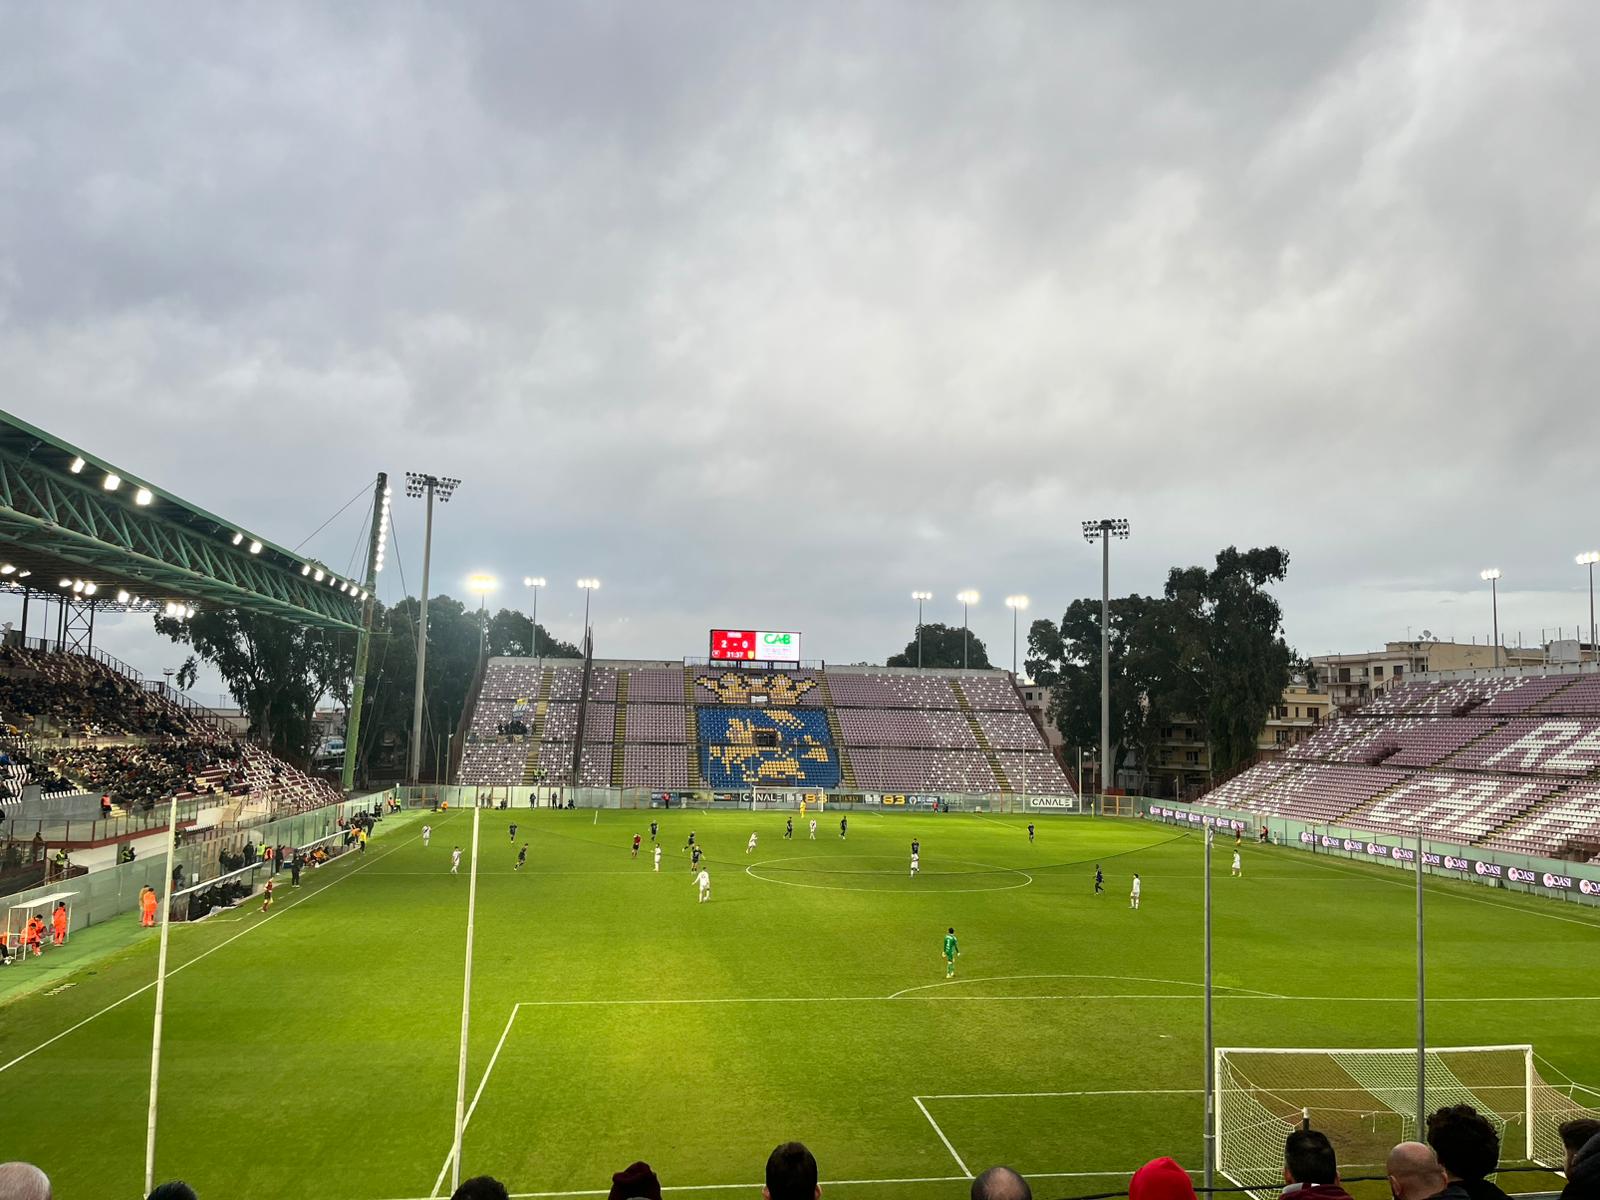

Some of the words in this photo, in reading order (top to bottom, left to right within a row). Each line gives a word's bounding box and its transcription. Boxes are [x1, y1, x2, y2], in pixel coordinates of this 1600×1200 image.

[721, 640, 727, 648] 2
[882, 795, 906, 805] 83
[1032, 798, 1070, 806] CANALE
[1399, 849, 1414, 859] OASI
[1452, 858, 1468, 868] OASI
[1483, 863, 1501, 874] OASI
[1517, 869, 1535, 881] OASI
[1552, 875, 1572, 887] OASI
